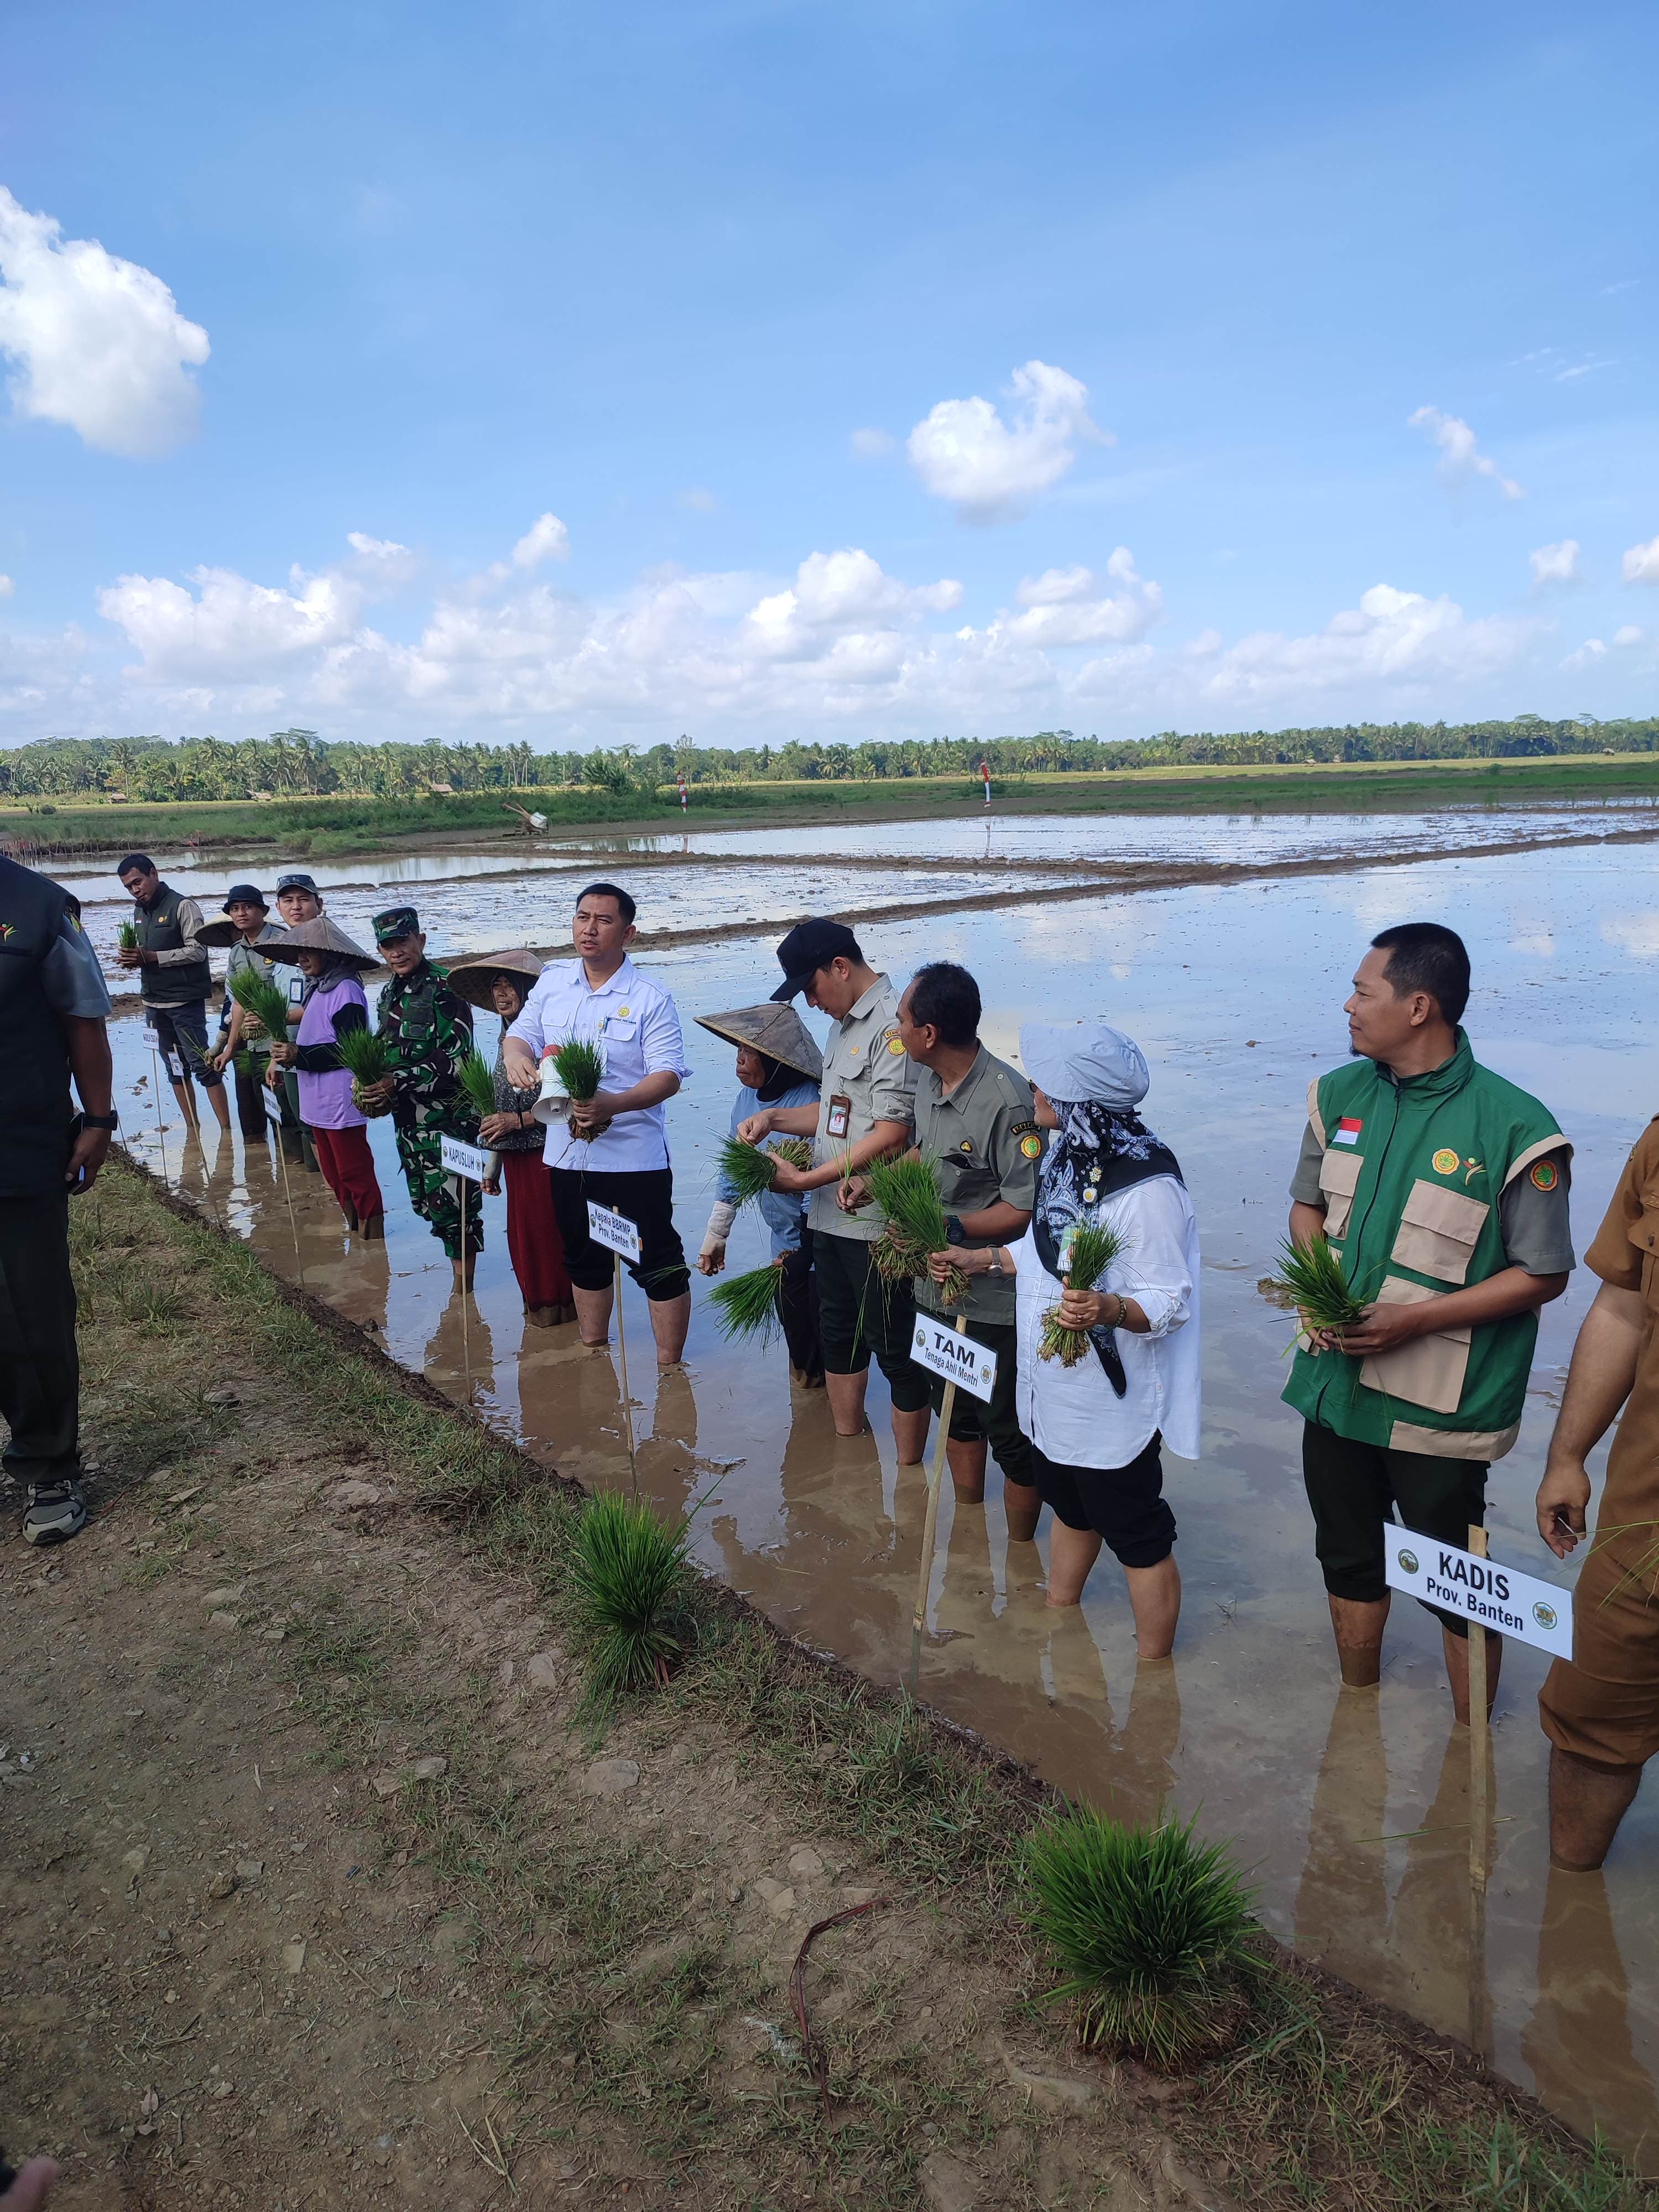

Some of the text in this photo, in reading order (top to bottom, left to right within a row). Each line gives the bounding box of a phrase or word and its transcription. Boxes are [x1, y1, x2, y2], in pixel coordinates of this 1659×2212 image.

[448, 1146, 474, 1170] KAPUSLUH
[594, 1208, 630, 1235] Kepala BBRMP
[598, 1224, 629, 1249] Prov. Banten
[925, 1348, 978, 1387] Tenaga Ahli Mentri
[934, 1332, 975, 1369] TAM
[1439, 1551, 1510, 1601] KADIS
[1427, 1577, 1523, 1631] Prov. Banten
